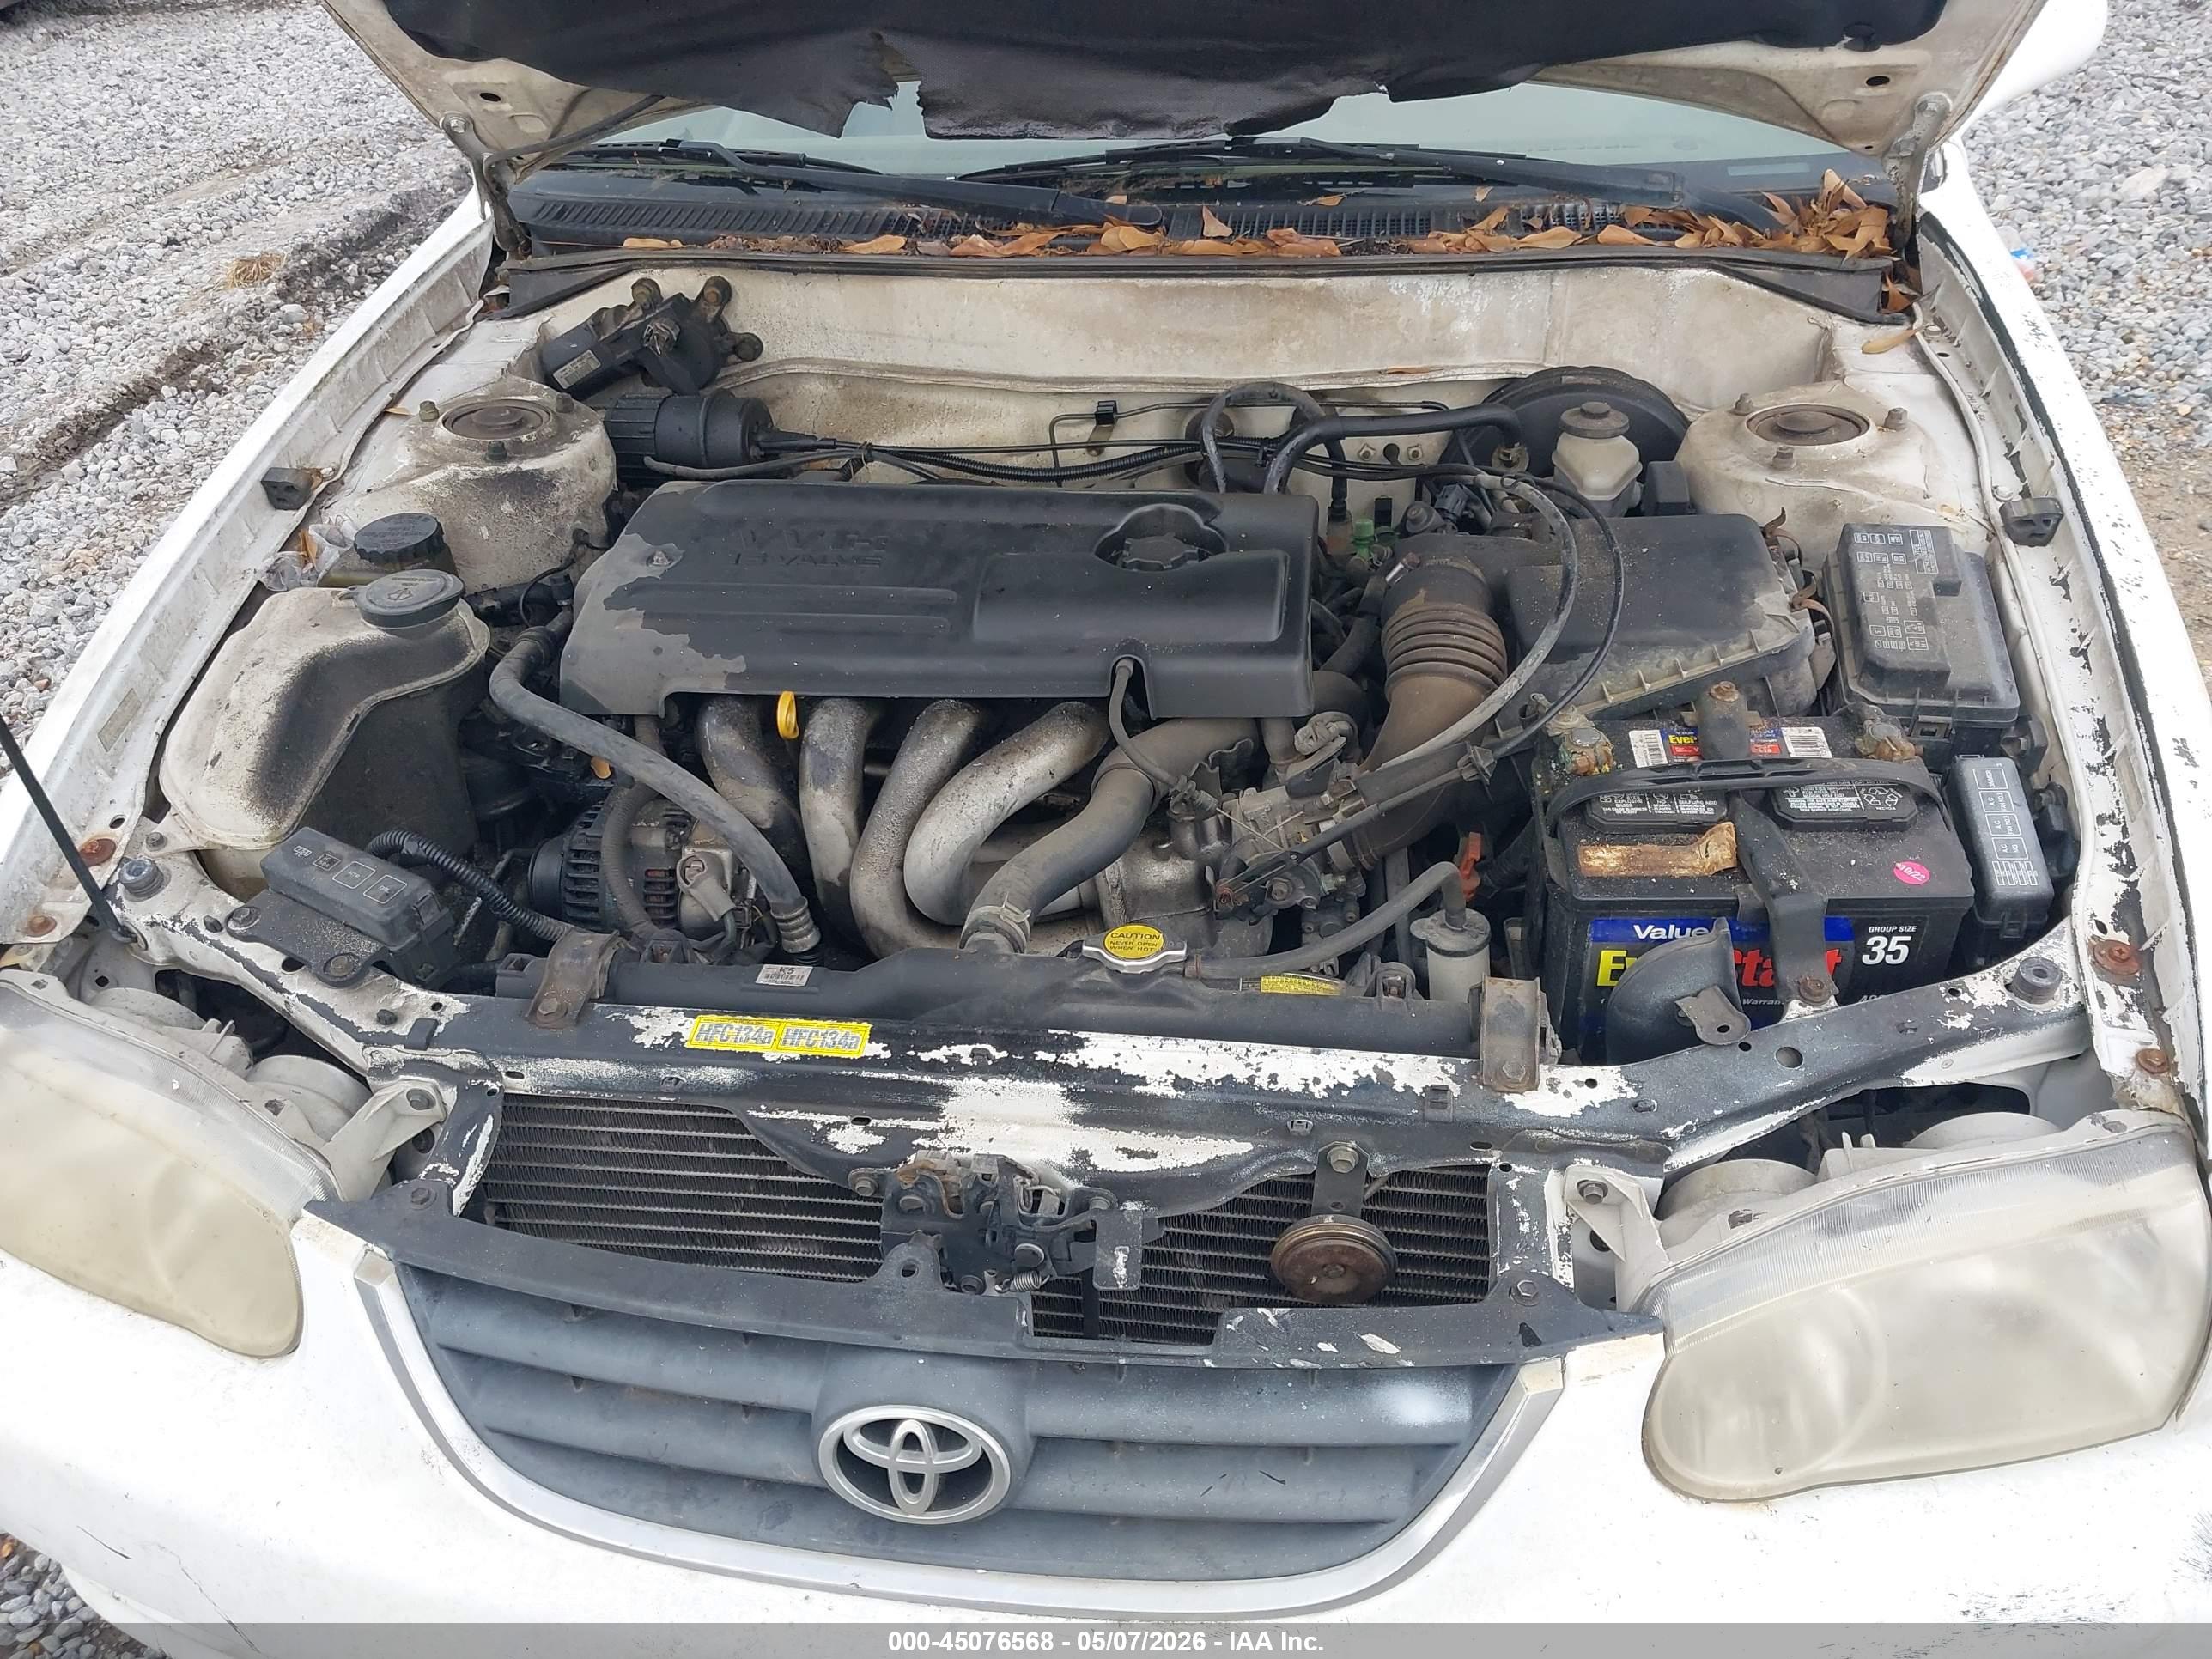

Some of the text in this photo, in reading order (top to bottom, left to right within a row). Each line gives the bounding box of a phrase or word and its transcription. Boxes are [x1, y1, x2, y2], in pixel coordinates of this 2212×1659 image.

[1110, 932, 1160, 940] CAUTION
[1632, 924, 1710, 939] Value
[1862, 935, 1912, 965] 35
